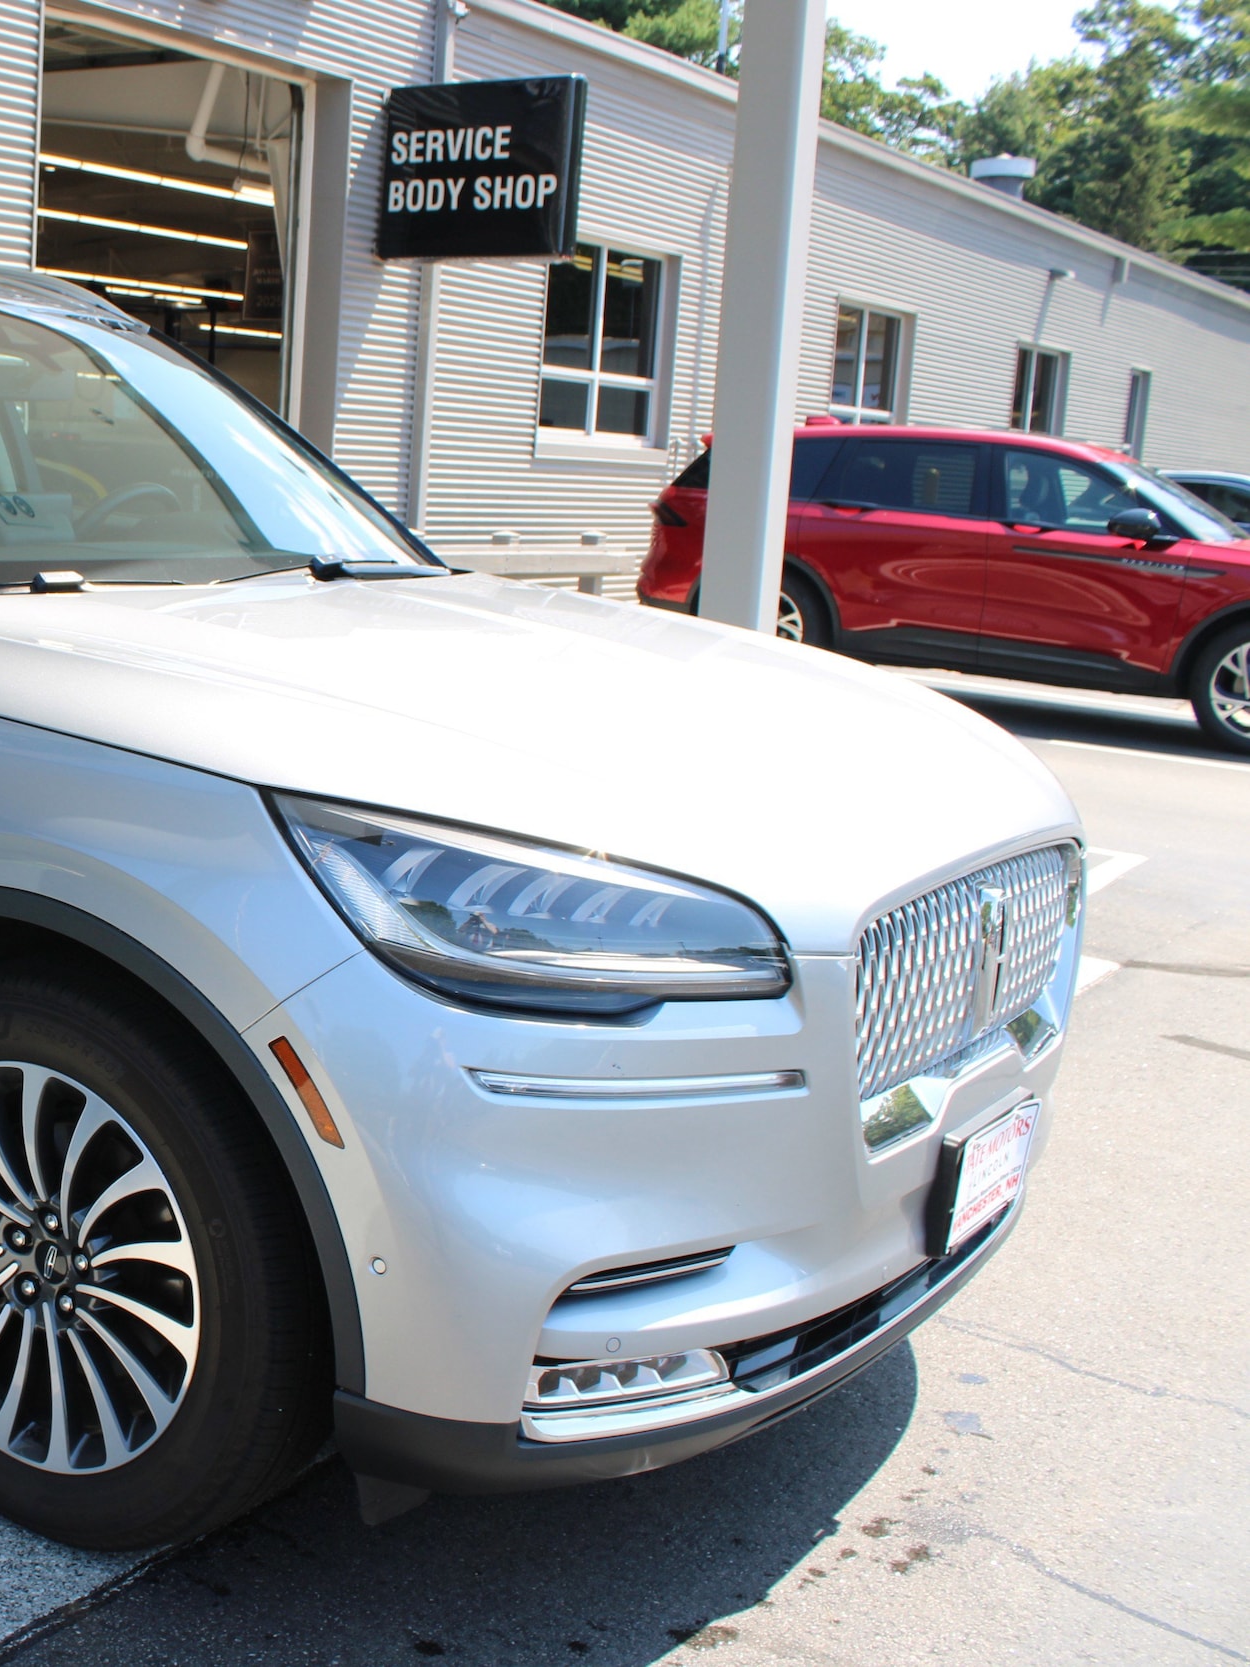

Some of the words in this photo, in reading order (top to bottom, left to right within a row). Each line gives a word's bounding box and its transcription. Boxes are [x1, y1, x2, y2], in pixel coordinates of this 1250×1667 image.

[391, 125, 512, 165] SERVICE
[387, 177, 466, 212] BODY
[473, 174, 558, 211] SHOP
[989, 1115, 1033, 1154] MOTORS
[972, 1151, 1009, 1188] LINCOLN
[1006, 1172, 1020, 1190] NH
